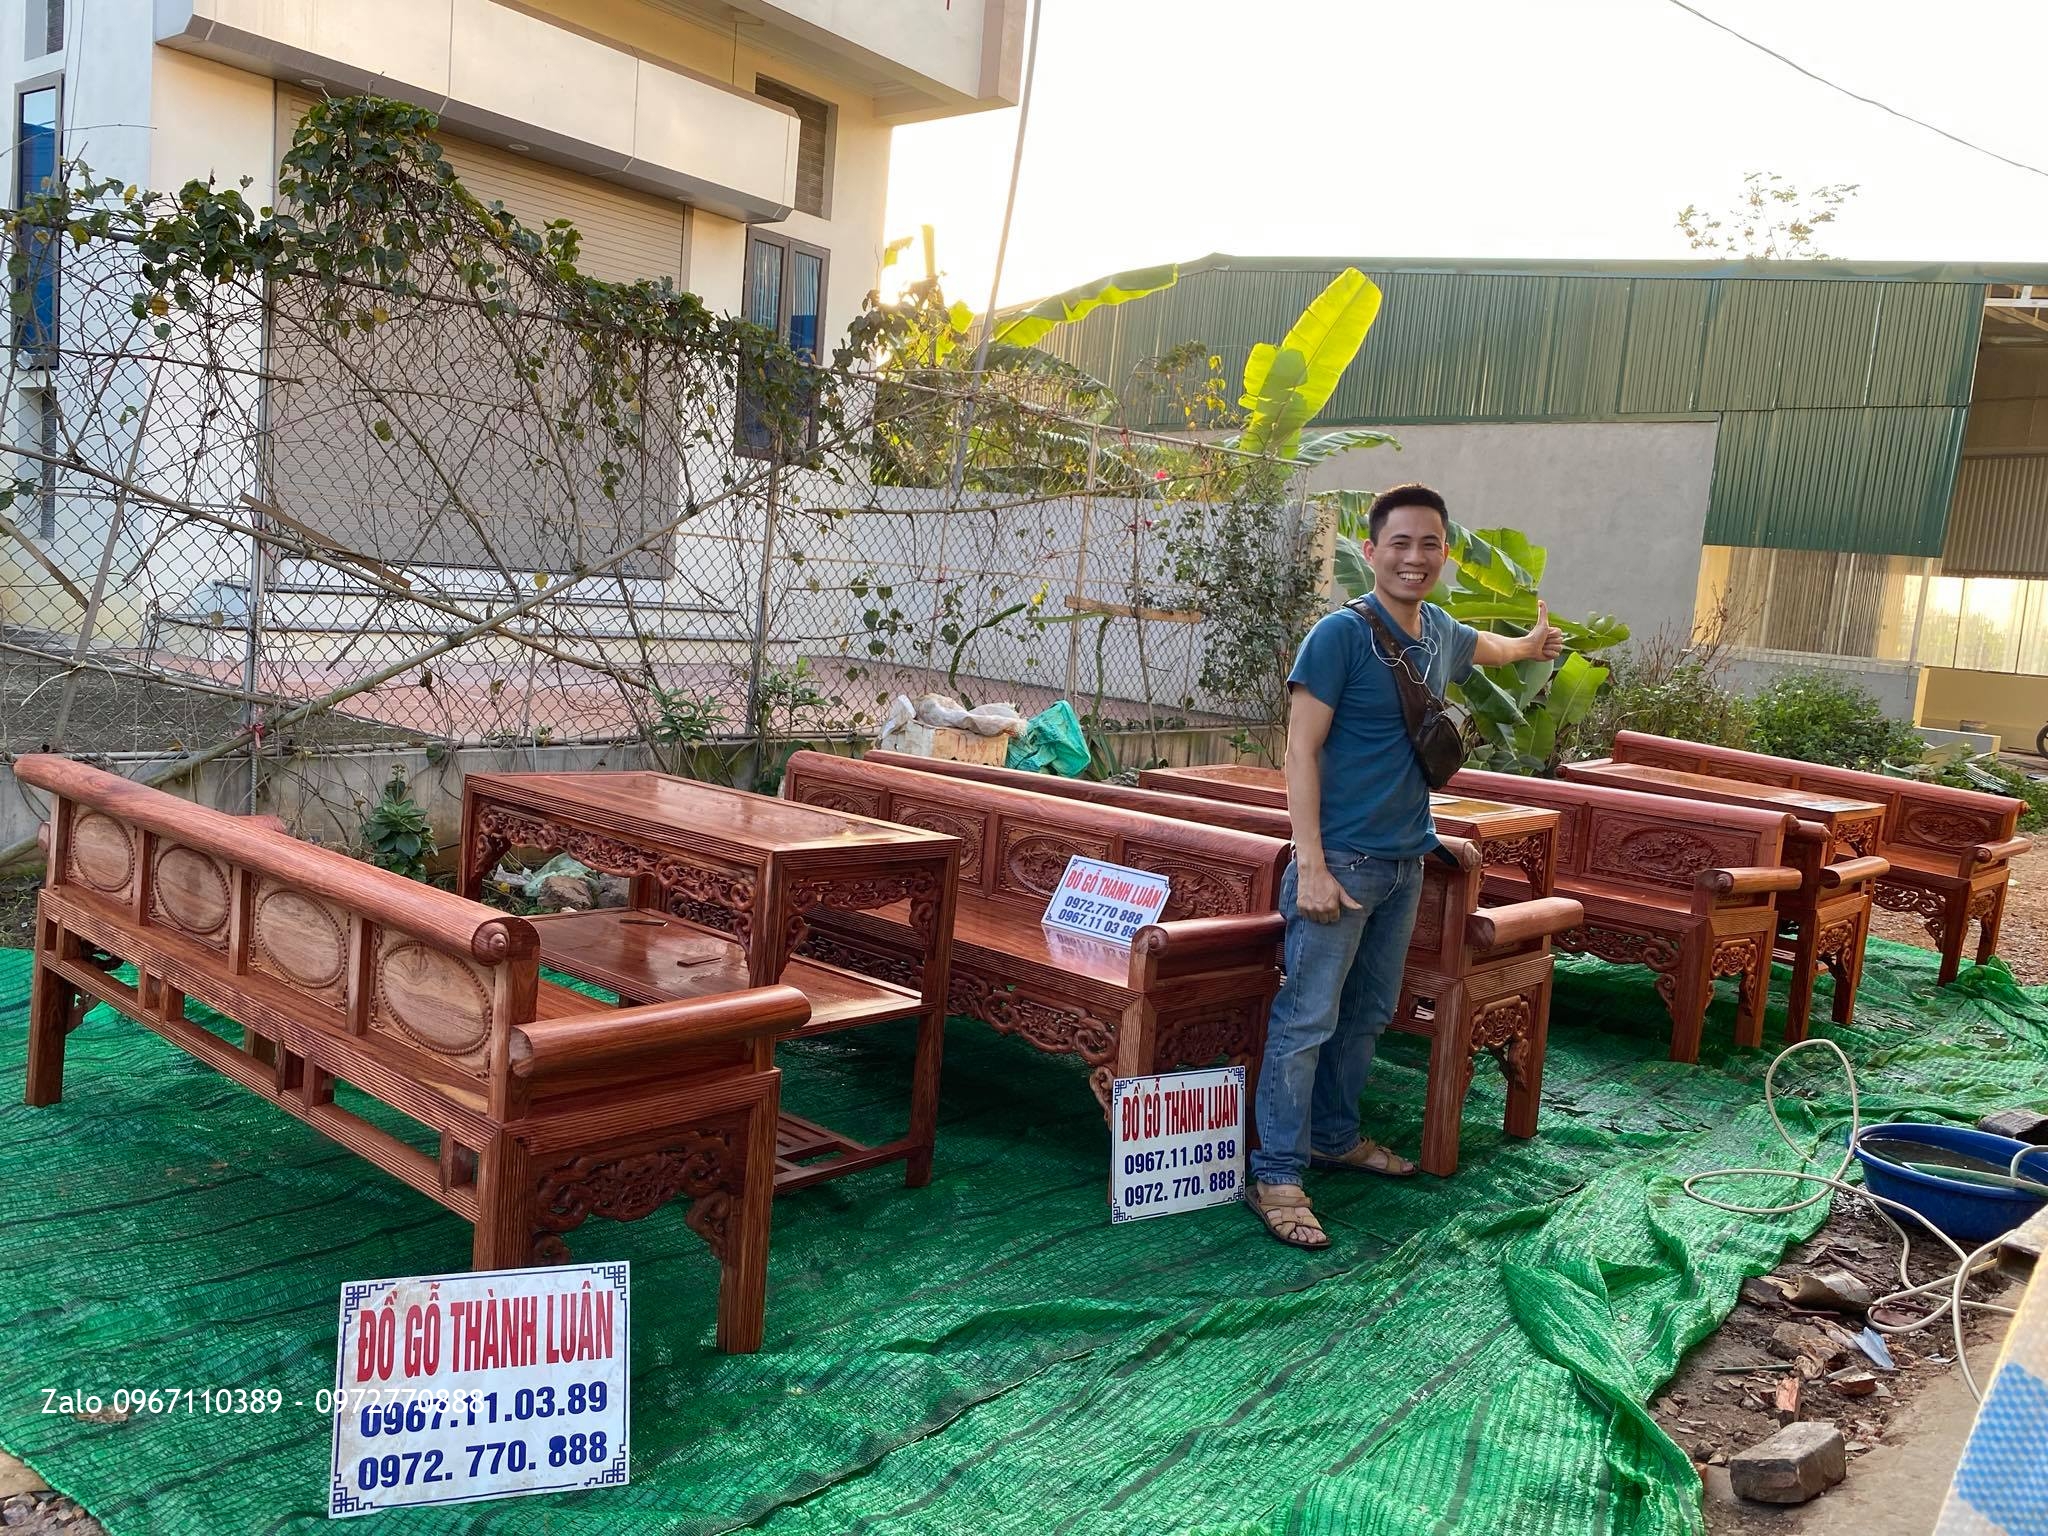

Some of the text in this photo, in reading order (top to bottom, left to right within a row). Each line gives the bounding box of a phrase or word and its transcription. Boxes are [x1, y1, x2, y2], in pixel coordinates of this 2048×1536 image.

[1058, 908, 1137, 938] 0967.11 03 89
[1065, 896, 1143, 925] 0972.770 888
[1122, 1075, 1238, 1142] ĐỒ GỖ THÀNH LUÂN
[1124, 1139, 1236, 1175] 0967.11.03 89
[1209, 1169, 1235, 1192] 888
[356, 1280, 614, 1383] ĐỒ GỖ THÀNH LUÂN
[548, 1431, 608, 1467] 888
